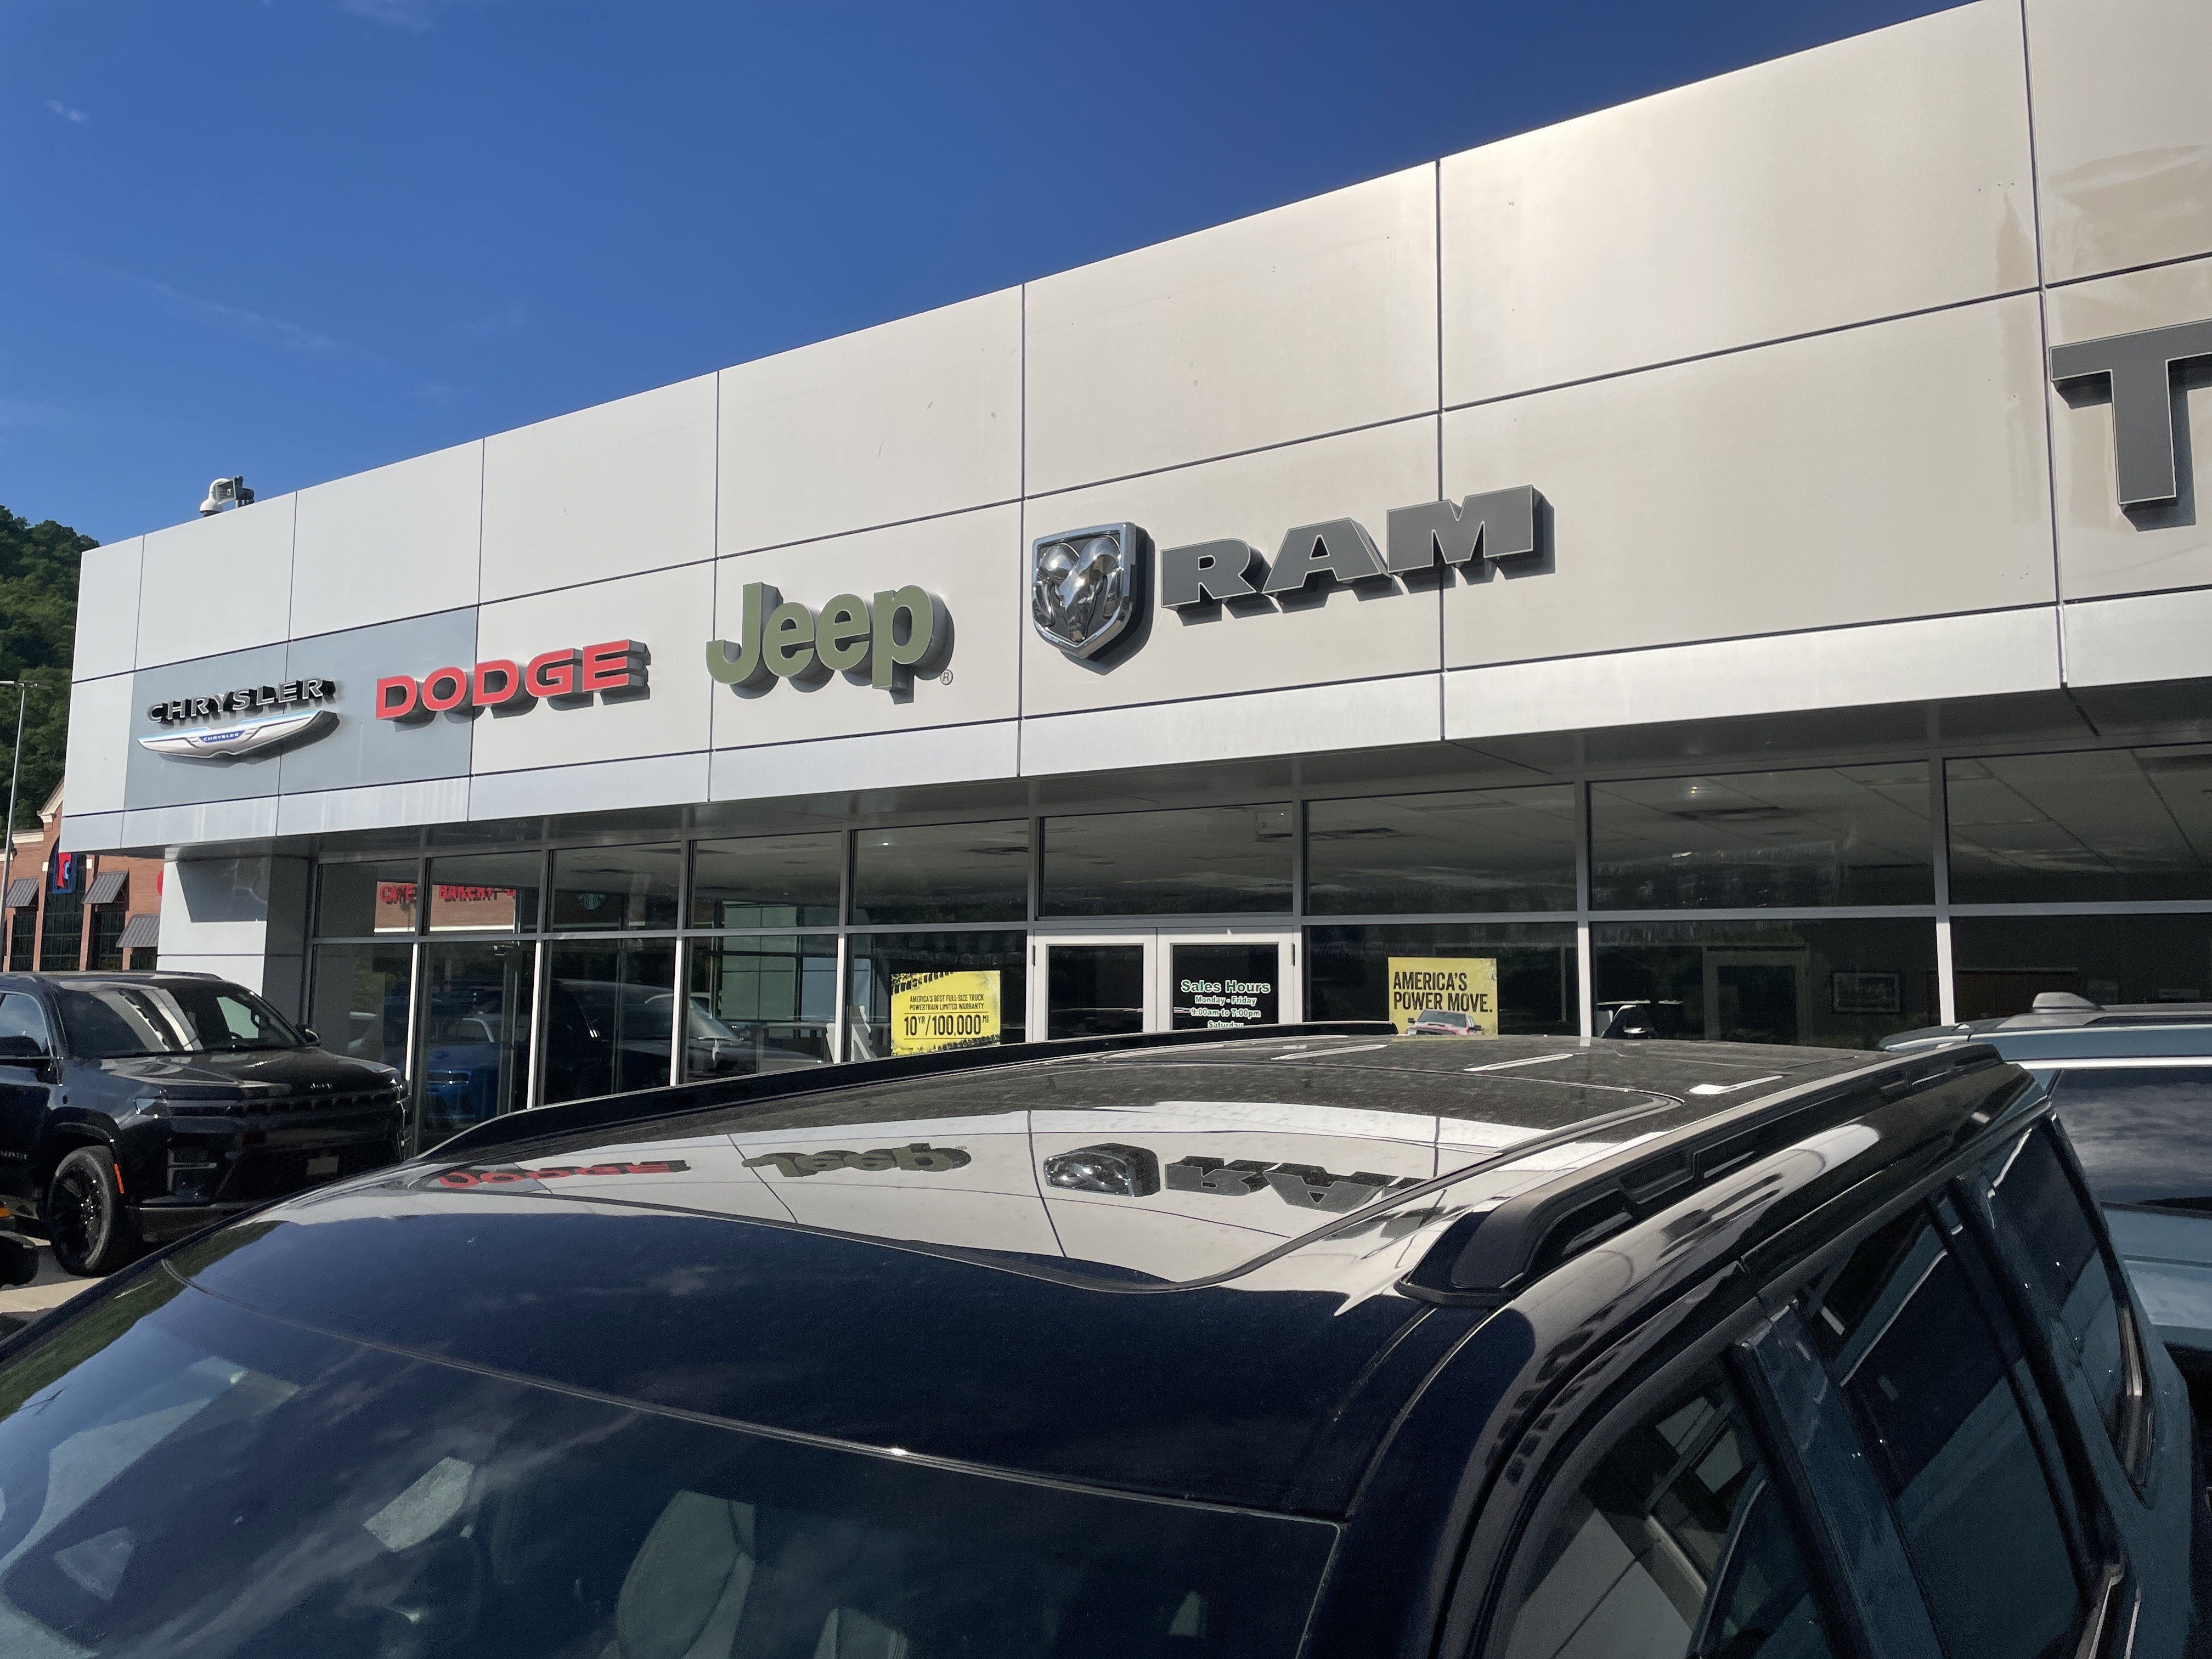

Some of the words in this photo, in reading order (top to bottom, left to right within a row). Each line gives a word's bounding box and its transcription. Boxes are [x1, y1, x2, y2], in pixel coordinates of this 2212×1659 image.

[1160, 484, 1534, 608] RAM
[706, 582, 934, 689] Jeep
[375, 639, 631, 720] DODGE
[146, 678, 324, 723] CHRYSLER
[202, 732, 239, 742] CHRYSLER
[1181, 979, 1222, 993] Sales
[1225, 980, 1271, 994] Hours
[1393, 971, 1468, 991] AMERICA'S
[910, 994, 933, 1003] AMERICA'S
[934, 994, 945, 1003] BEST
[946, 994, 968, 1002] FULL-SIZE
[969, 994, 984, 1002] TRUCK
[1194, 995, 1226, 1006] Monday
[1231, 996, 1257, 1006] Friday
[1394, 991, 1443, 1011] POWER
[1447, 992, 1493, 1013] MOVE.
[1190, 1007, 1220, 1017] 9:00am
[1221, 1008, 1230, 1017] to
[1231, 1008, 1261, 1019] 7:00pm
